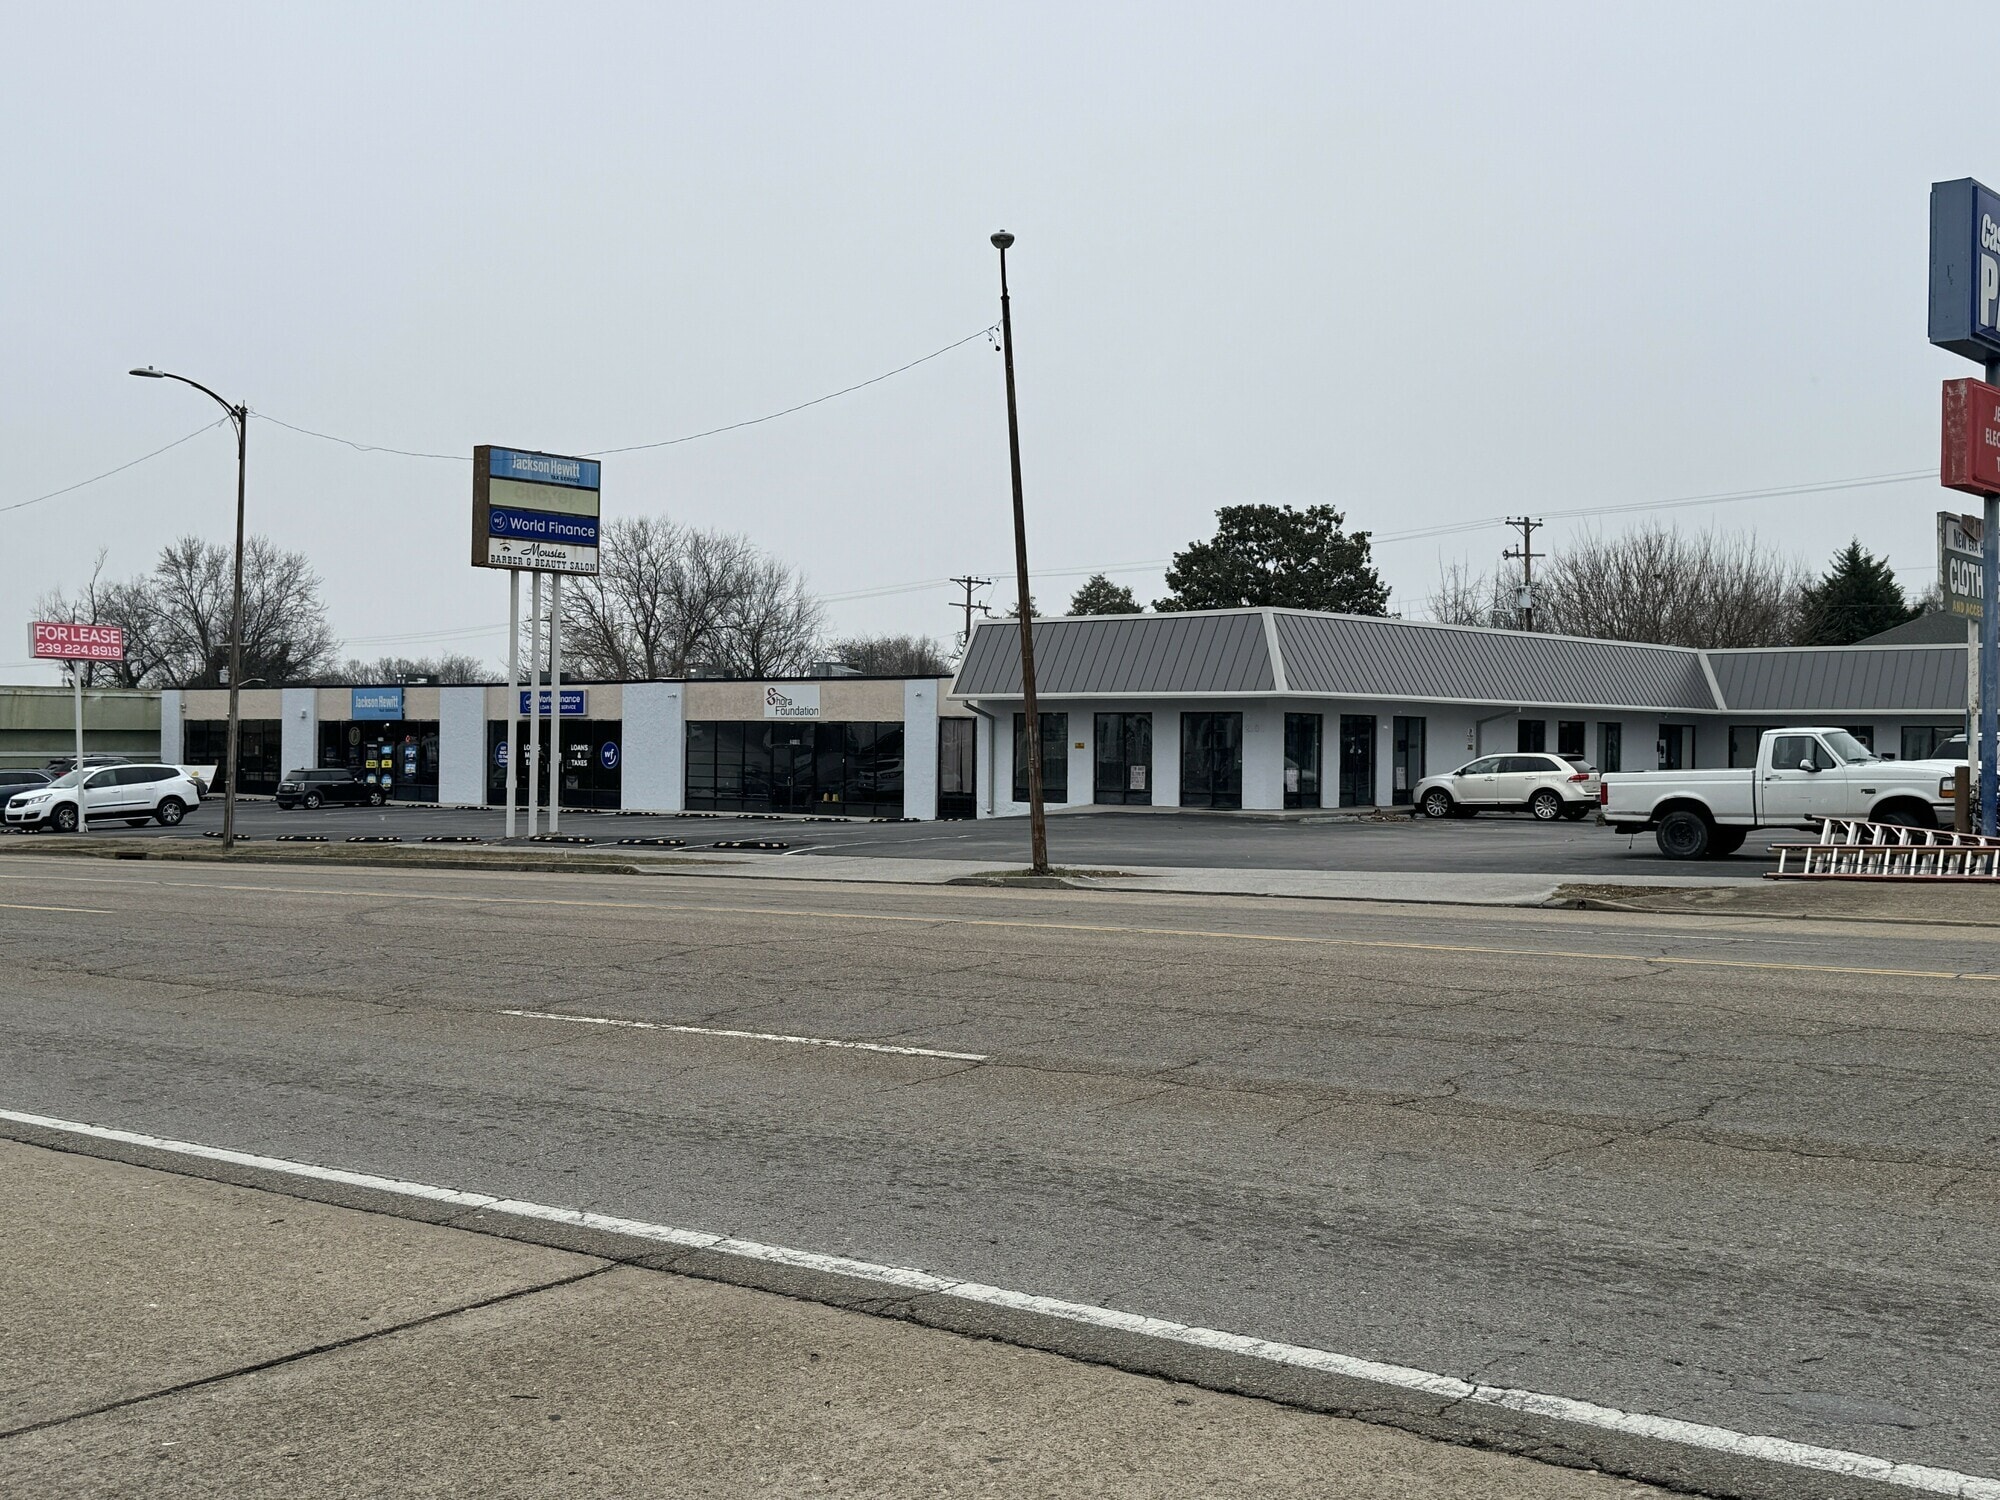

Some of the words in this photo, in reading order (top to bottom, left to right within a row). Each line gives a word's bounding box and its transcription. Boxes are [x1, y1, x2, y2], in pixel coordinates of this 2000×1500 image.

[1980, 252, 2000, 332] P
[512, 454, 549, 473] Jackson
[550, 459, 580, 477] Hewitt
[509, 517, 546, 532] World
[548, 521, 596, 537] Finance
[1953, 528, 1967, 551] NEW
[490, 555, 523, 566] BARBER
[535, 558, 567, 569] BEAUTY
[569, 561, 596, 572] SALON
[1949, 557, 1984, 600] CLOTH
[1952, 599, 1965, 614] AND
[36, 625, 68, 641] FOR
[70, 627, 120, 644] LEASE
[36, 642, 120, 656] 239.224.8919
[355, 695, 378, 708] Jackson
[378, 695, 399, 709] Hewitt
[560, 695, 581, 703] nance
[775, 705, 819, 716] Foundation
[570, 759, 588, 767] TAXES
